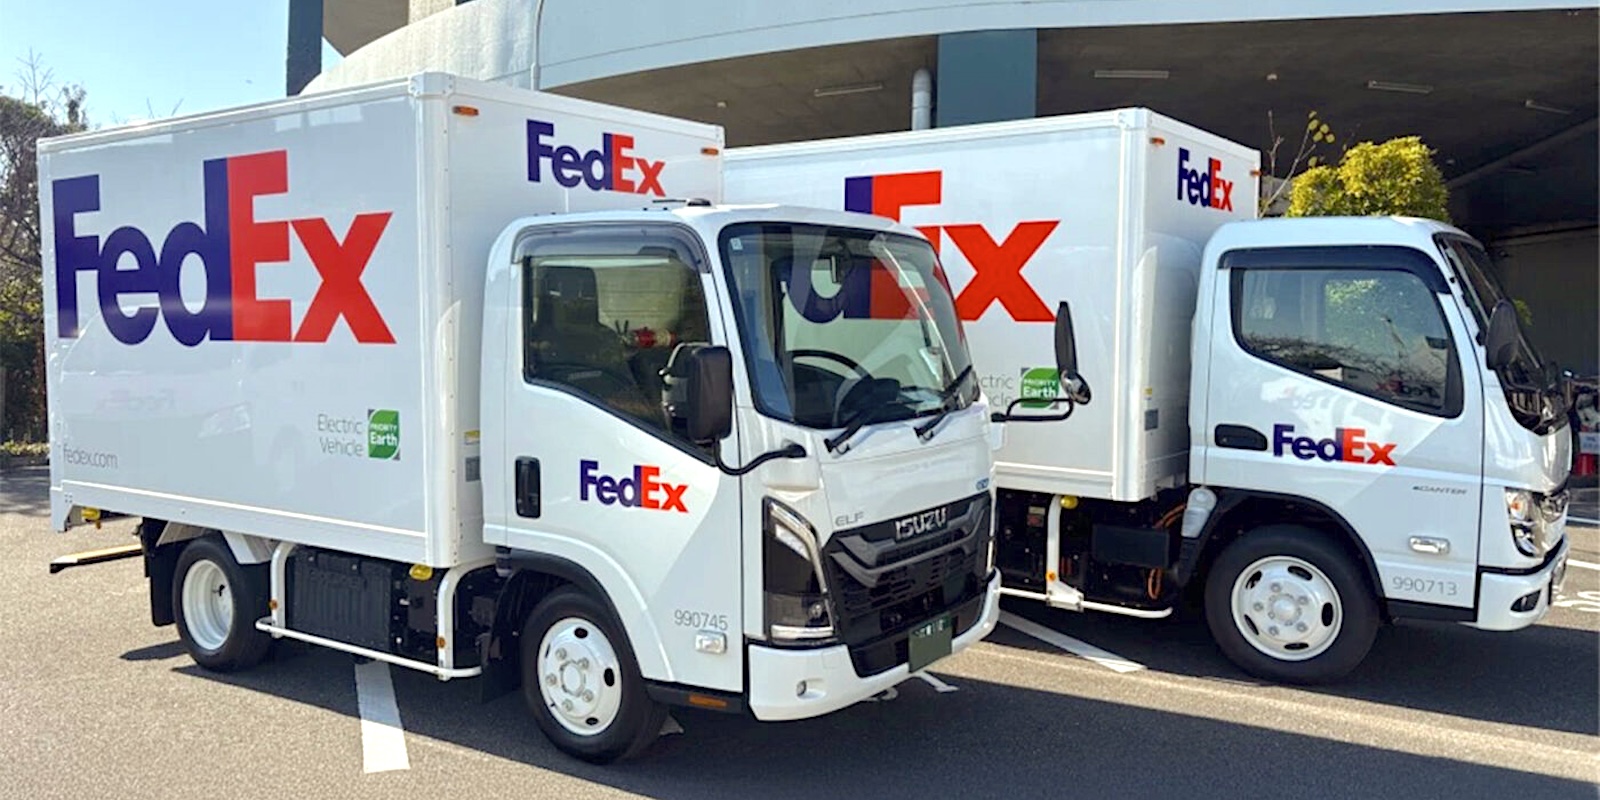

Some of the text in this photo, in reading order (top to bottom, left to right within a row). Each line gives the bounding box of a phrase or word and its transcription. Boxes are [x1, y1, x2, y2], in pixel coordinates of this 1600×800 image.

[526, 119, 666, 197] FedEx
[1177, 147, 1233, 213] FedEx
[52, 149, 396, 346] FedEx
[980, 374, 1014, 390] ctric
[1023, 386, 1057, 398] Earth
[317, 413, 363, 435] Electric
[319, 436, 363, 457] Vehicle
[370, 431, 398, 446] Earth
[1273, 423, 1397, 466] FedEx
[63, 443, 118, 470] fedex.com
[580, 459, 689, 513] FedEx
[835, 511, 864, 526] ELF
[894, 507, 946, 540] ISUZU
[1392, 576, 1458, 596] 990713
[674, 609, 728, 631] 990745
